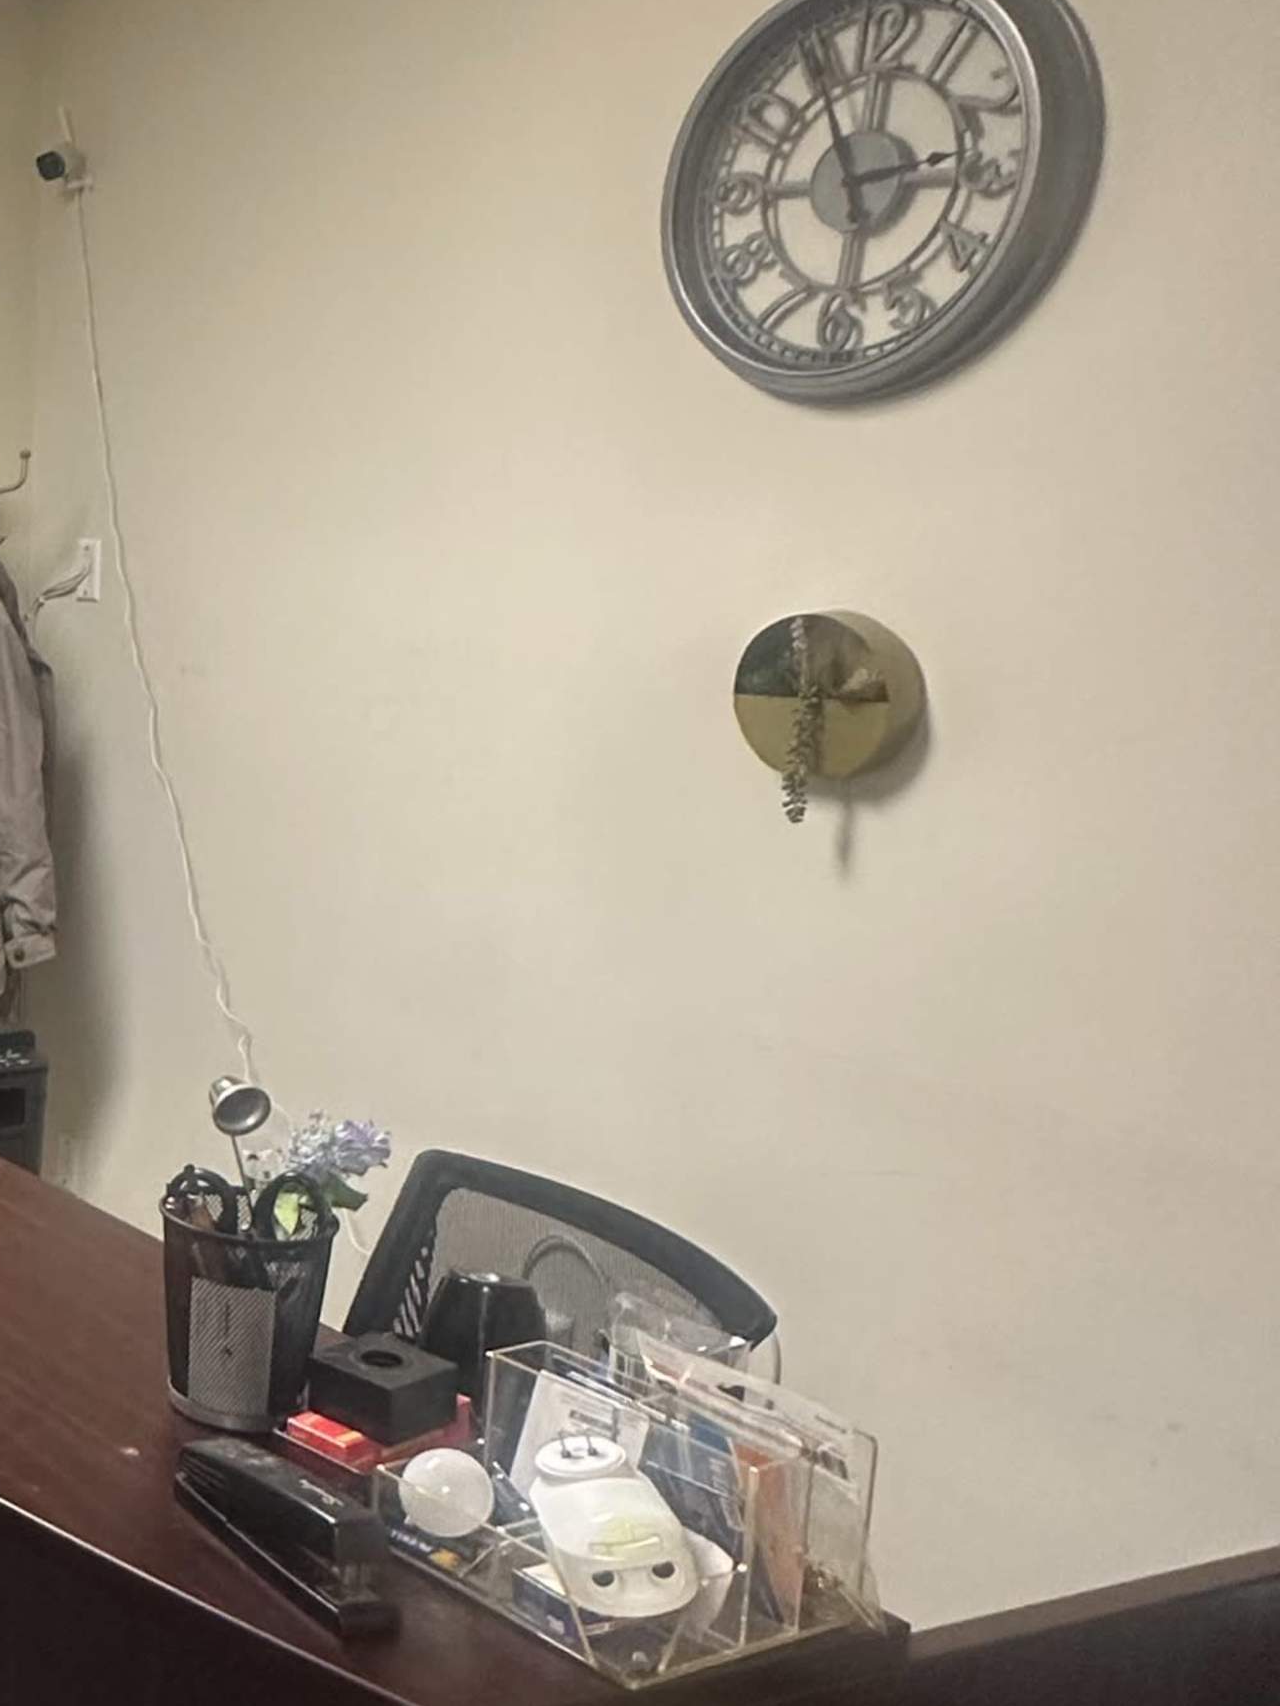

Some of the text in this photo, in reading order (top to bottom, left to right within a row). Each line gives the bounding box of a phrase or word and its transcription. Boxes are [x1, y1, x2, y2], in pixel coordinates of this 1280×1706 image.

[859, 1, 915, 71] 12
[930, 17, 981, 83] 1
[738, 91, 800, 151] 10
[714, 172, 766, 215] 9
[960, 149, 1018, 198] 3
[720, 231, 774, 283] 8
[942, 221, 990, 273] 4
[817, 291, 864, 350] 6
[882, 273, 932, 331] 5
